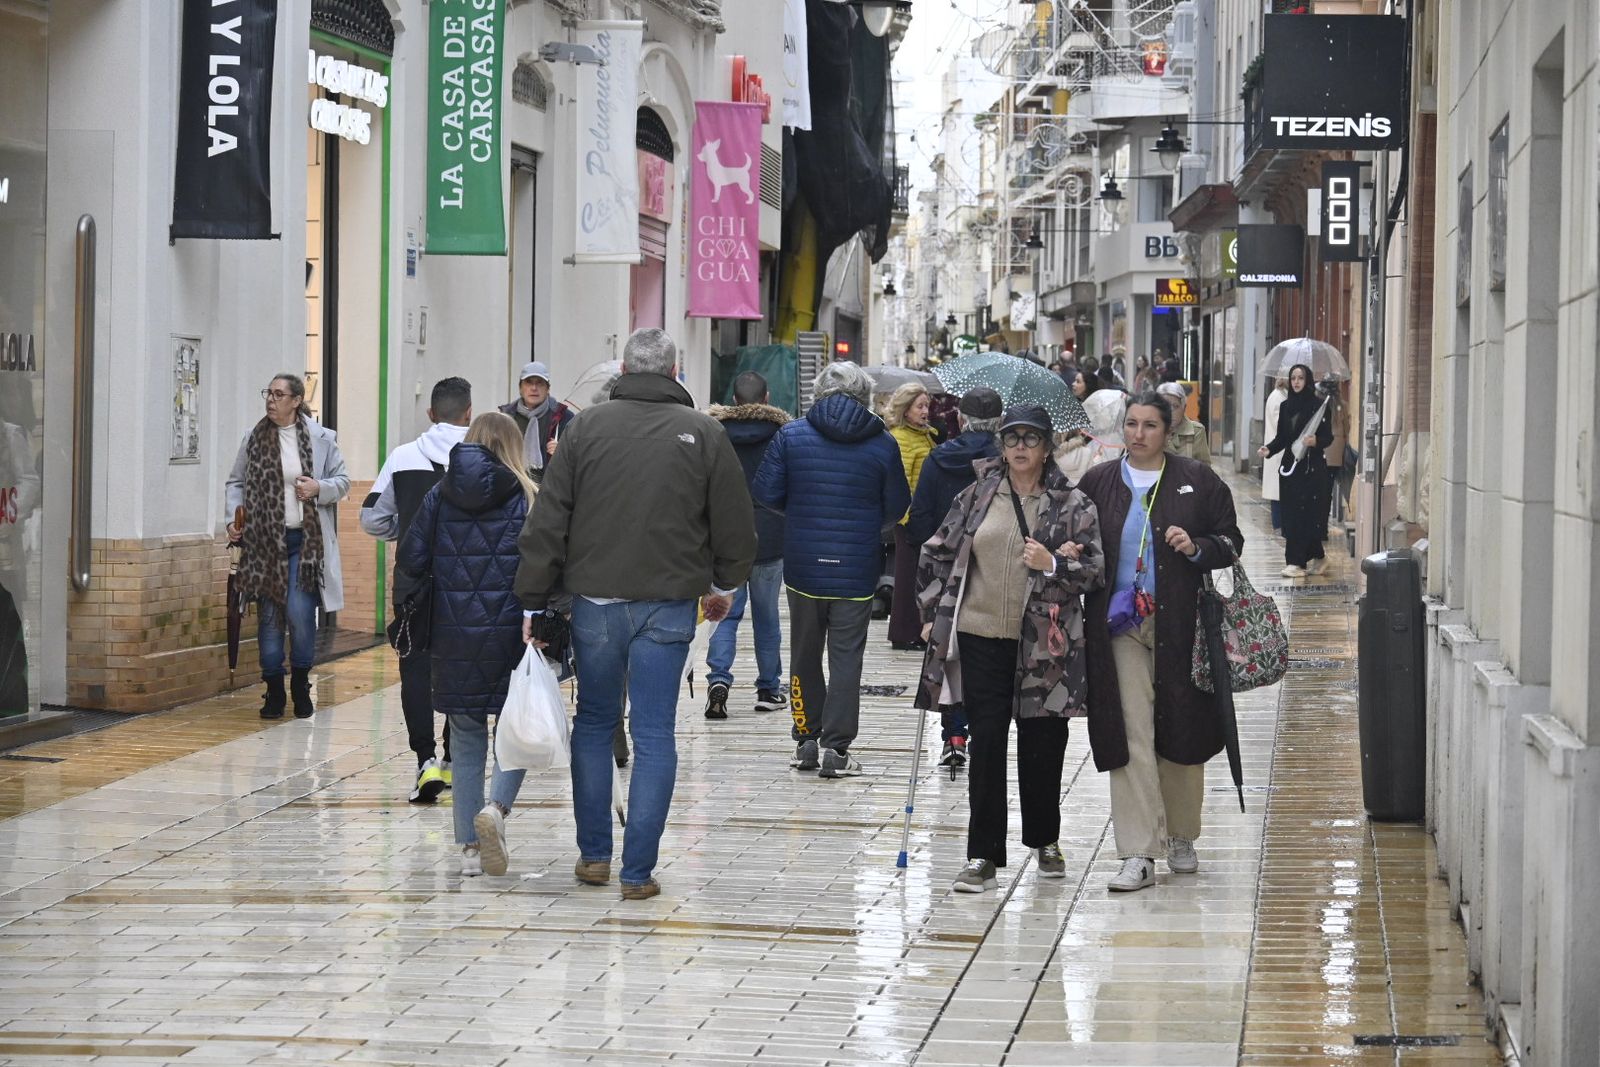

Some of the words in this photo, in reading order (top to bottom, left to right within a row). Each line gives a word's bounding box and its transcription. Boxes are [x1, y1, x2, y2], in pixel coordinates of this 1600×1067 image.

[210, 15, 242, 45] Y
[443, 16, 466, 58] DE
[208, 54, 241, 158] LOLA
[442, 65, 465, 151] CASA
[441, 163, 463, 209] LA
[698, 215, 746, 237] CHI
[697, 261, 751, 282] GUA
[1240, 273, 1297, 282] CALZEDONIA
[1, 332, 36, 371] LOLA
[791, 675, 811, 735] adidas
